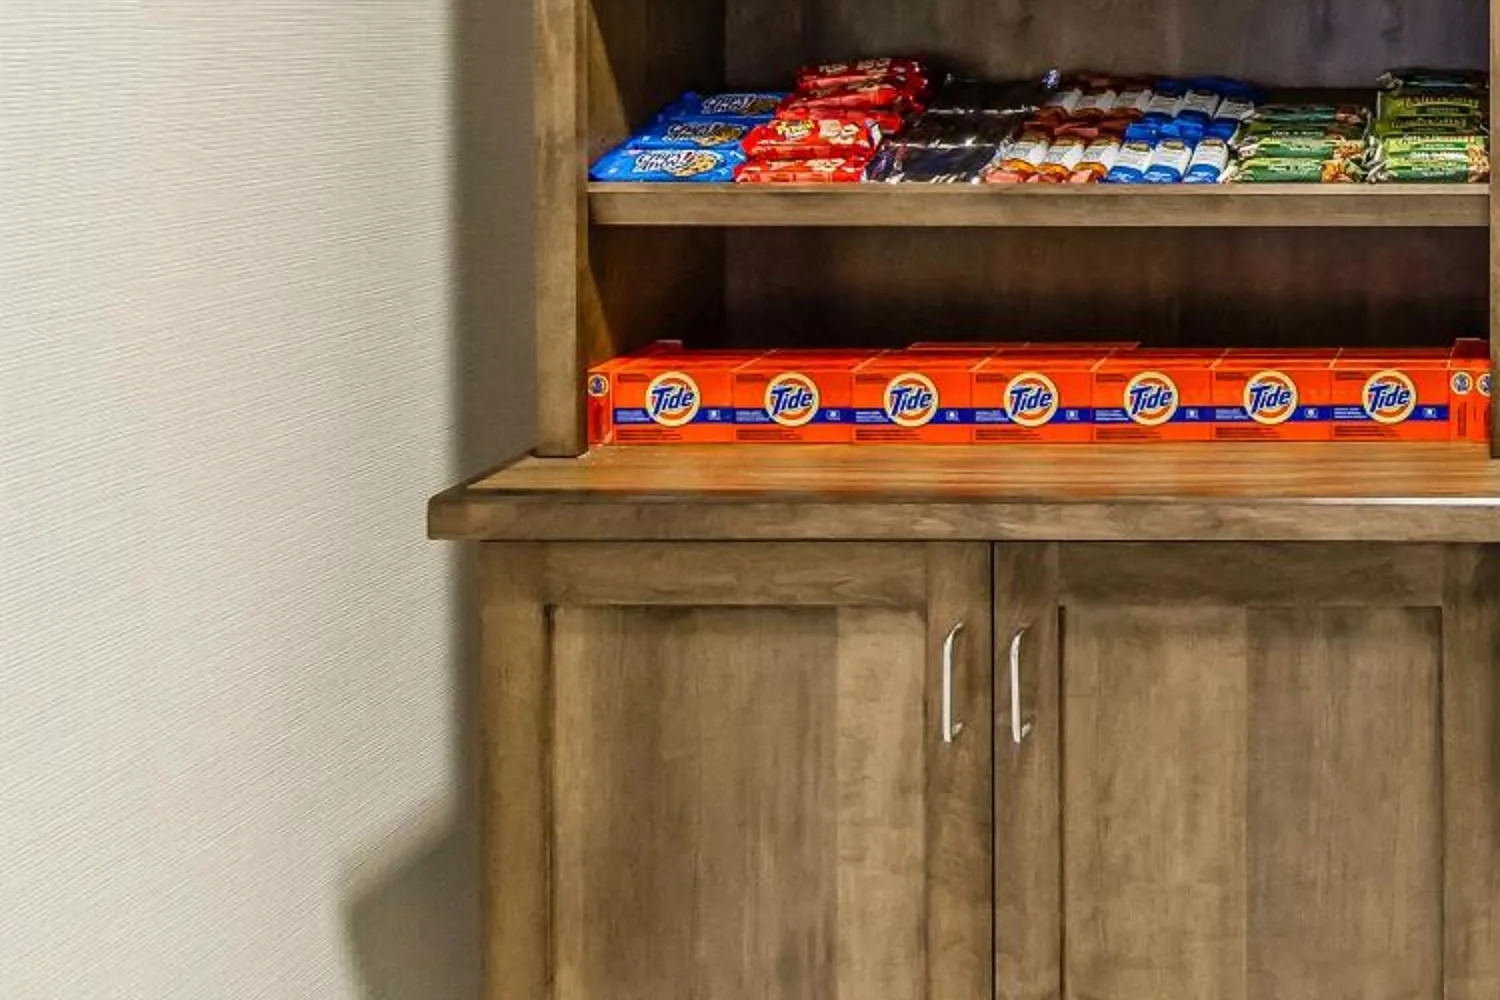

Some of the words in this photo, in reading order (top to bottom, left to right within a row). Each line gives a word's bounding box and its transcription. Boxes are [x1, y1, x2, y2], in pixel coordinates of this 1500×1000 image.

[651, 386, 695, 415] Tide
[771, 386, 814, 414] Tide
[890, 386, 933, 416] Tide
[1010, 386, 1053, 416] Tide
[1130, 385, 1173, 415] Tide
[1250, 385, 1293, 414] Tide
[1368, 384, 1411, 413] Tide
